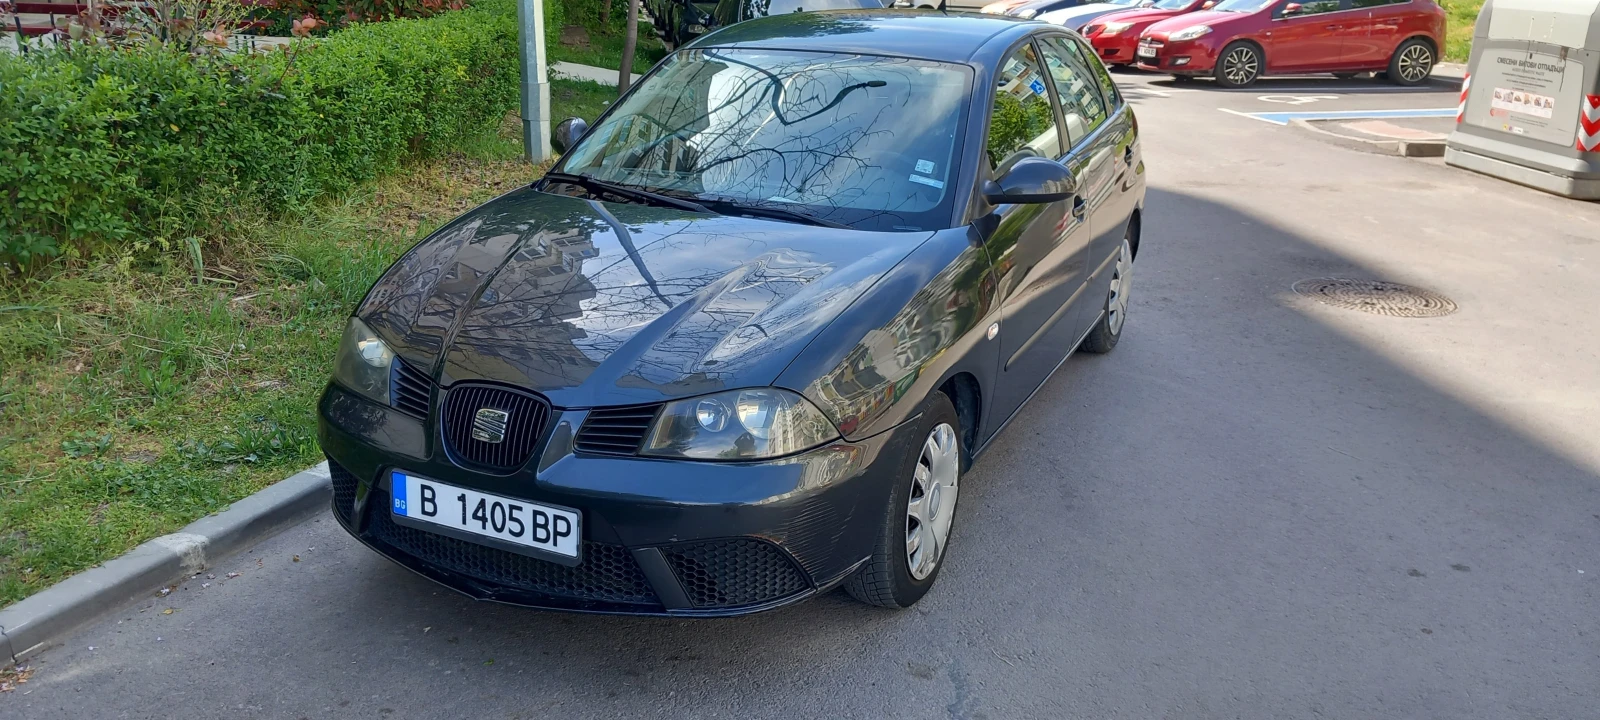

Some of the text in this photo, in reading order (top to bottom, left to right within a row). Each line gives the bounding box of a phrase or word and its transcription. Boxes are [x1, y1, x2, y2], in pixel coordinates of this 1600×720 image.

[394, 498, 406, 510] BG
[420, 483, 572, 547] B 1405 BP
